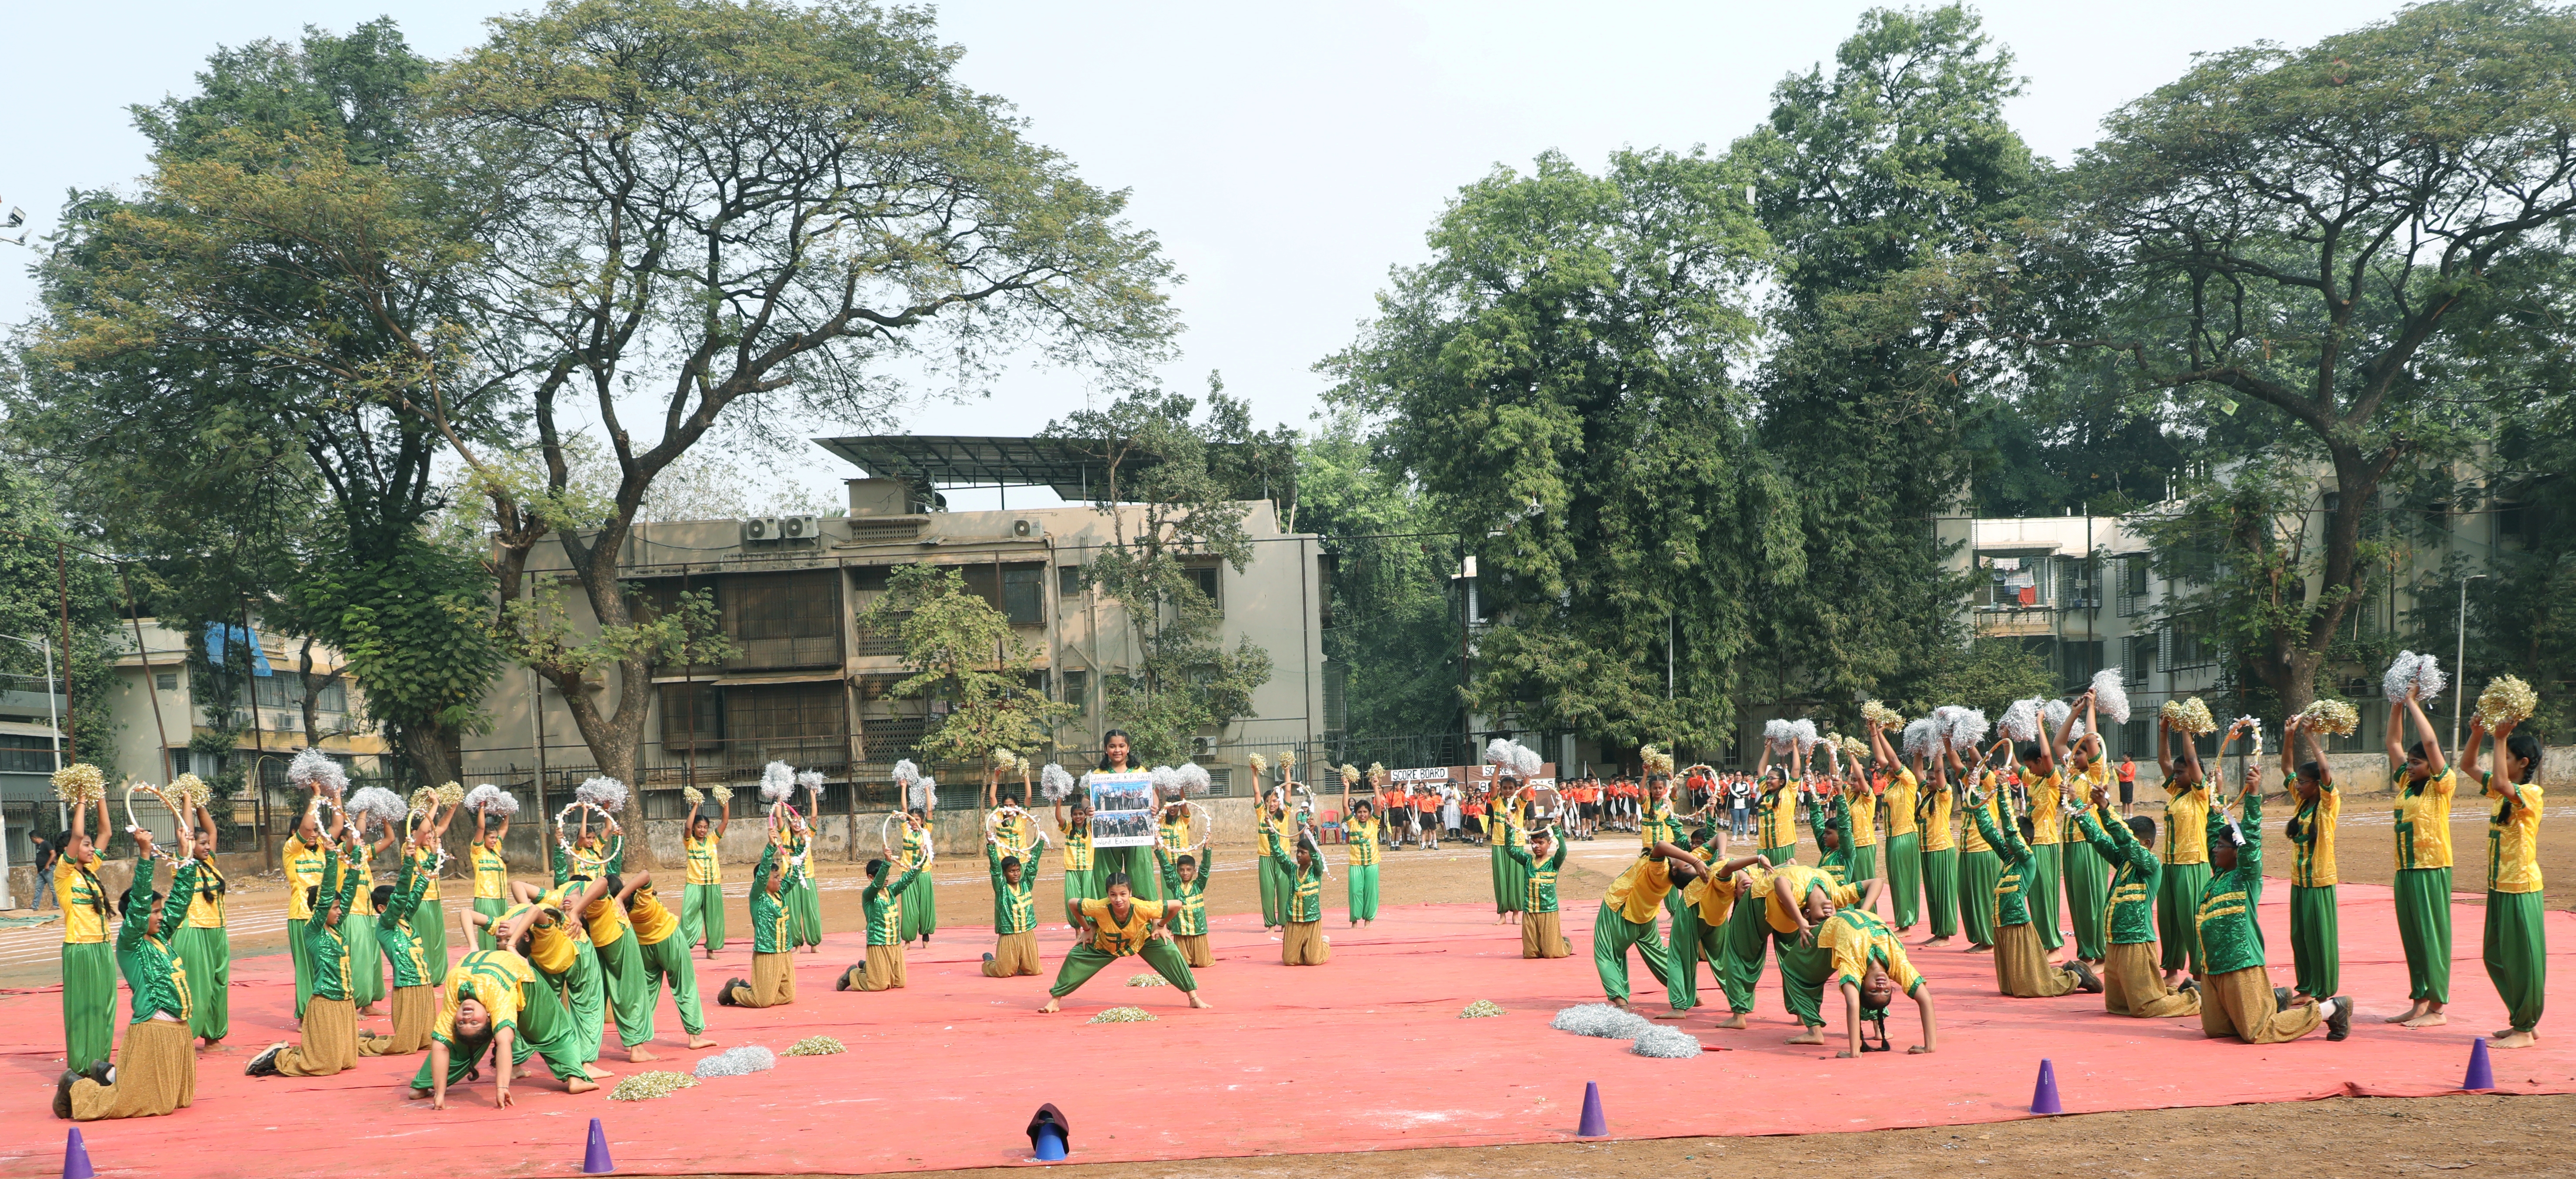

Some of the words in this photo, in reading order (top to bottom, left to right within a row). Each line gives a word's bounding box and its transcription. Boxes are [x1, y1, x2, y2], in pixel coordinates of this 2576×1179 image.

[1393, 769, 1417, 780] SCORE
[1421, 768, 1445, 779] BOARD
[1485, 766, 1509, 775] SCRE
